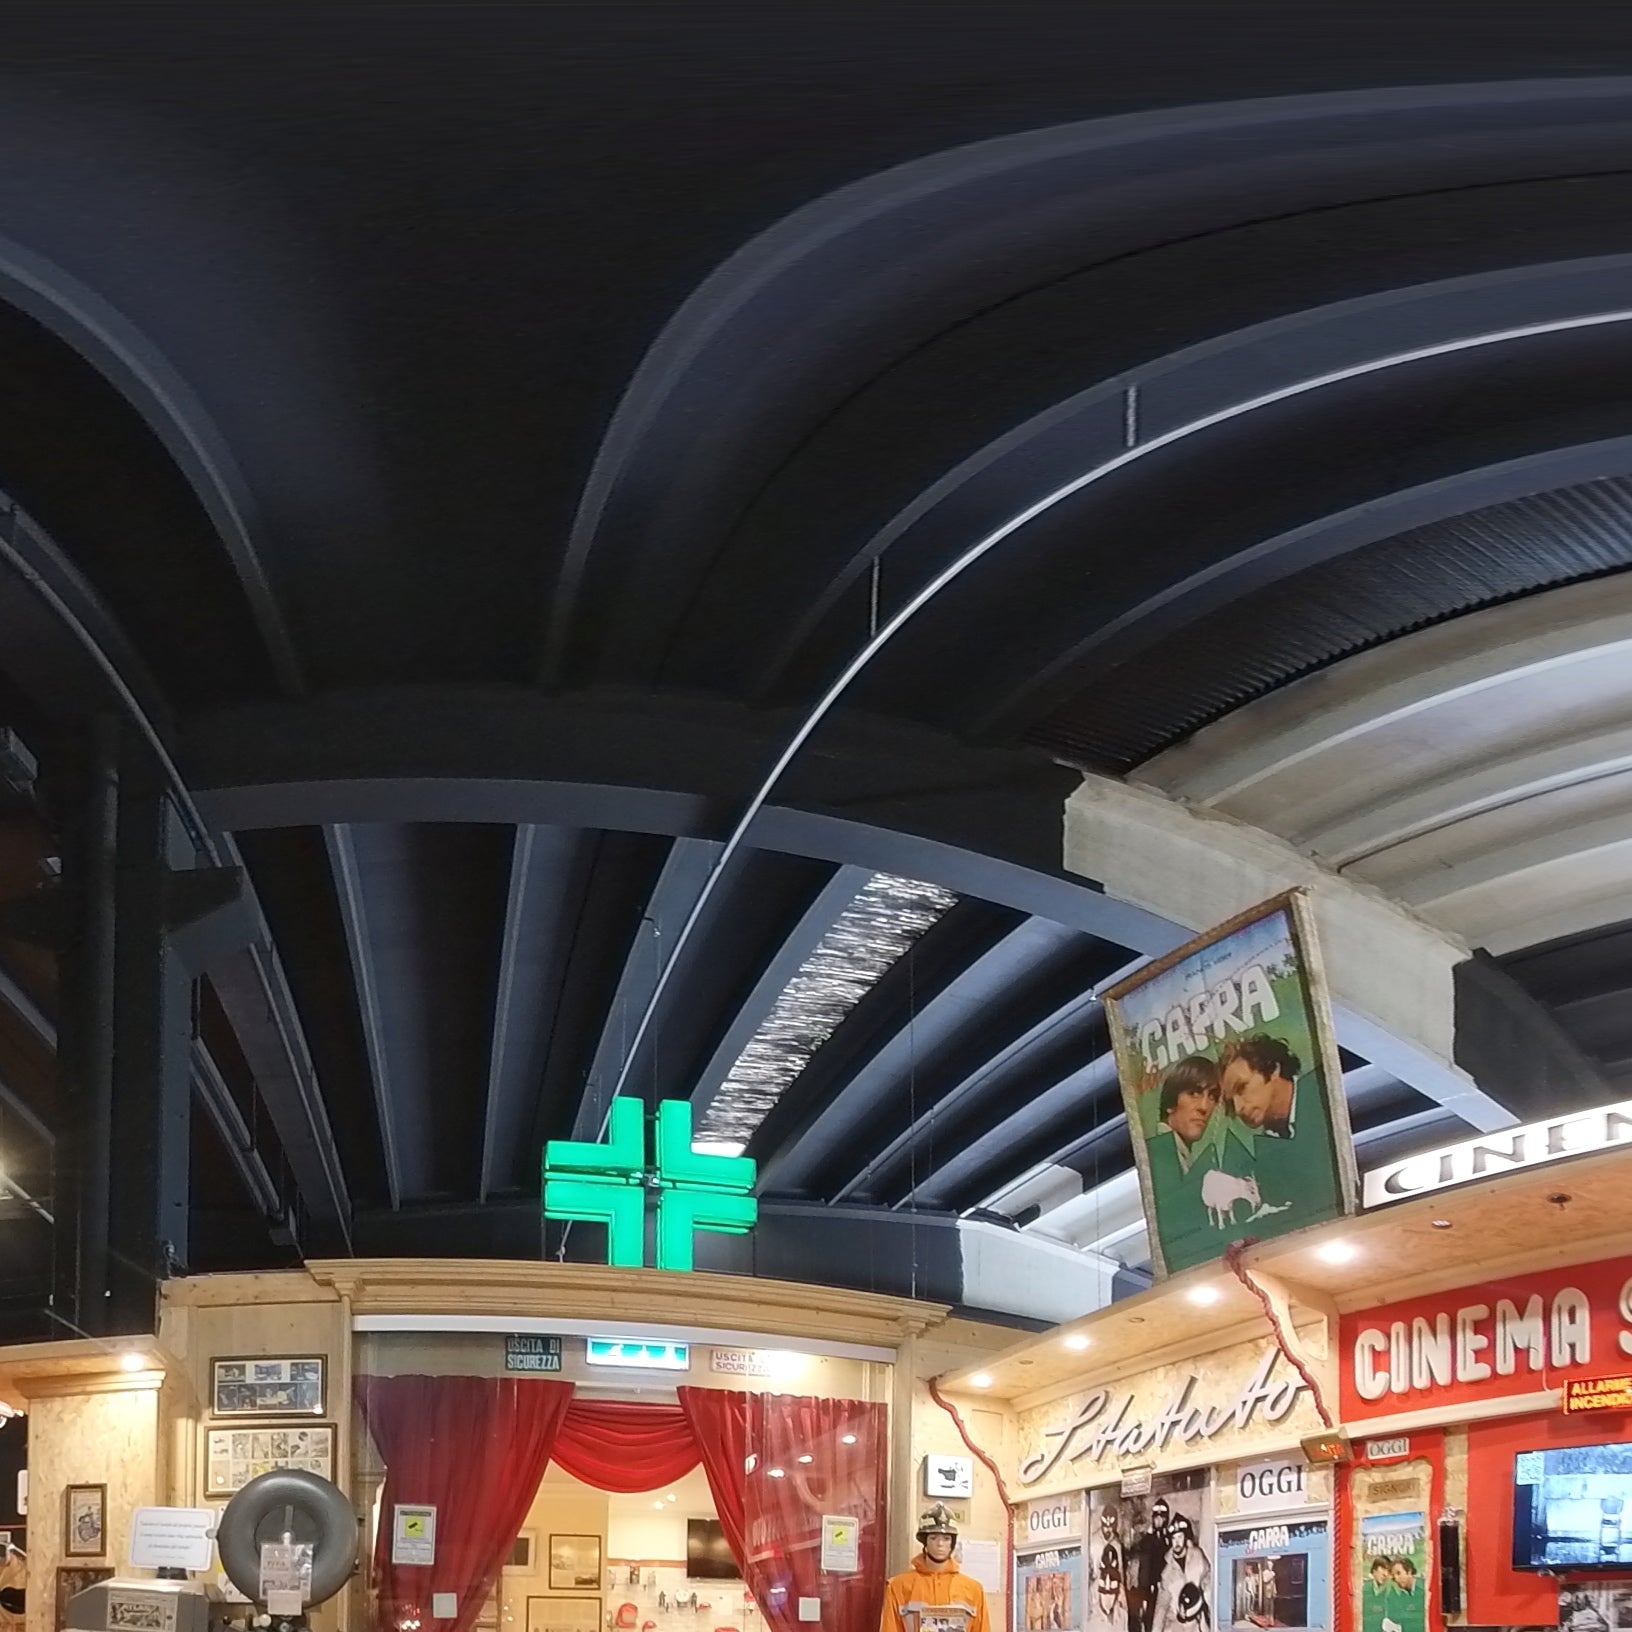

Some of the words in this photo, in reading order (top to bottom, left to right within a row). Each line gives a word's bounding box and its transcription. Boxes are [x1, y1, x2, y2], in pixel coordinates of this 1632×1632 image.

[1141, 964, 1280, 1069] CAPRA
[507, 1336, 543, 1353] USCITA
[550, 1340, 560, 1354] DI
[1354, 1287, 1590, 1400] CINEMA
[507, 1353, 560, 1370] SICUREZZA
[1019, 1347, 1311, 1484] Statuto
[1370, 1439, 1407, 1456] OGGI
[1240, 1465, 1304, 1499] OGGI
[1030, 1507, 1068, 1531] OGGI
[1248, 1525, 1290, 1551] CAPRA
[1035, 1551, 1061, 1568] CAPRA
